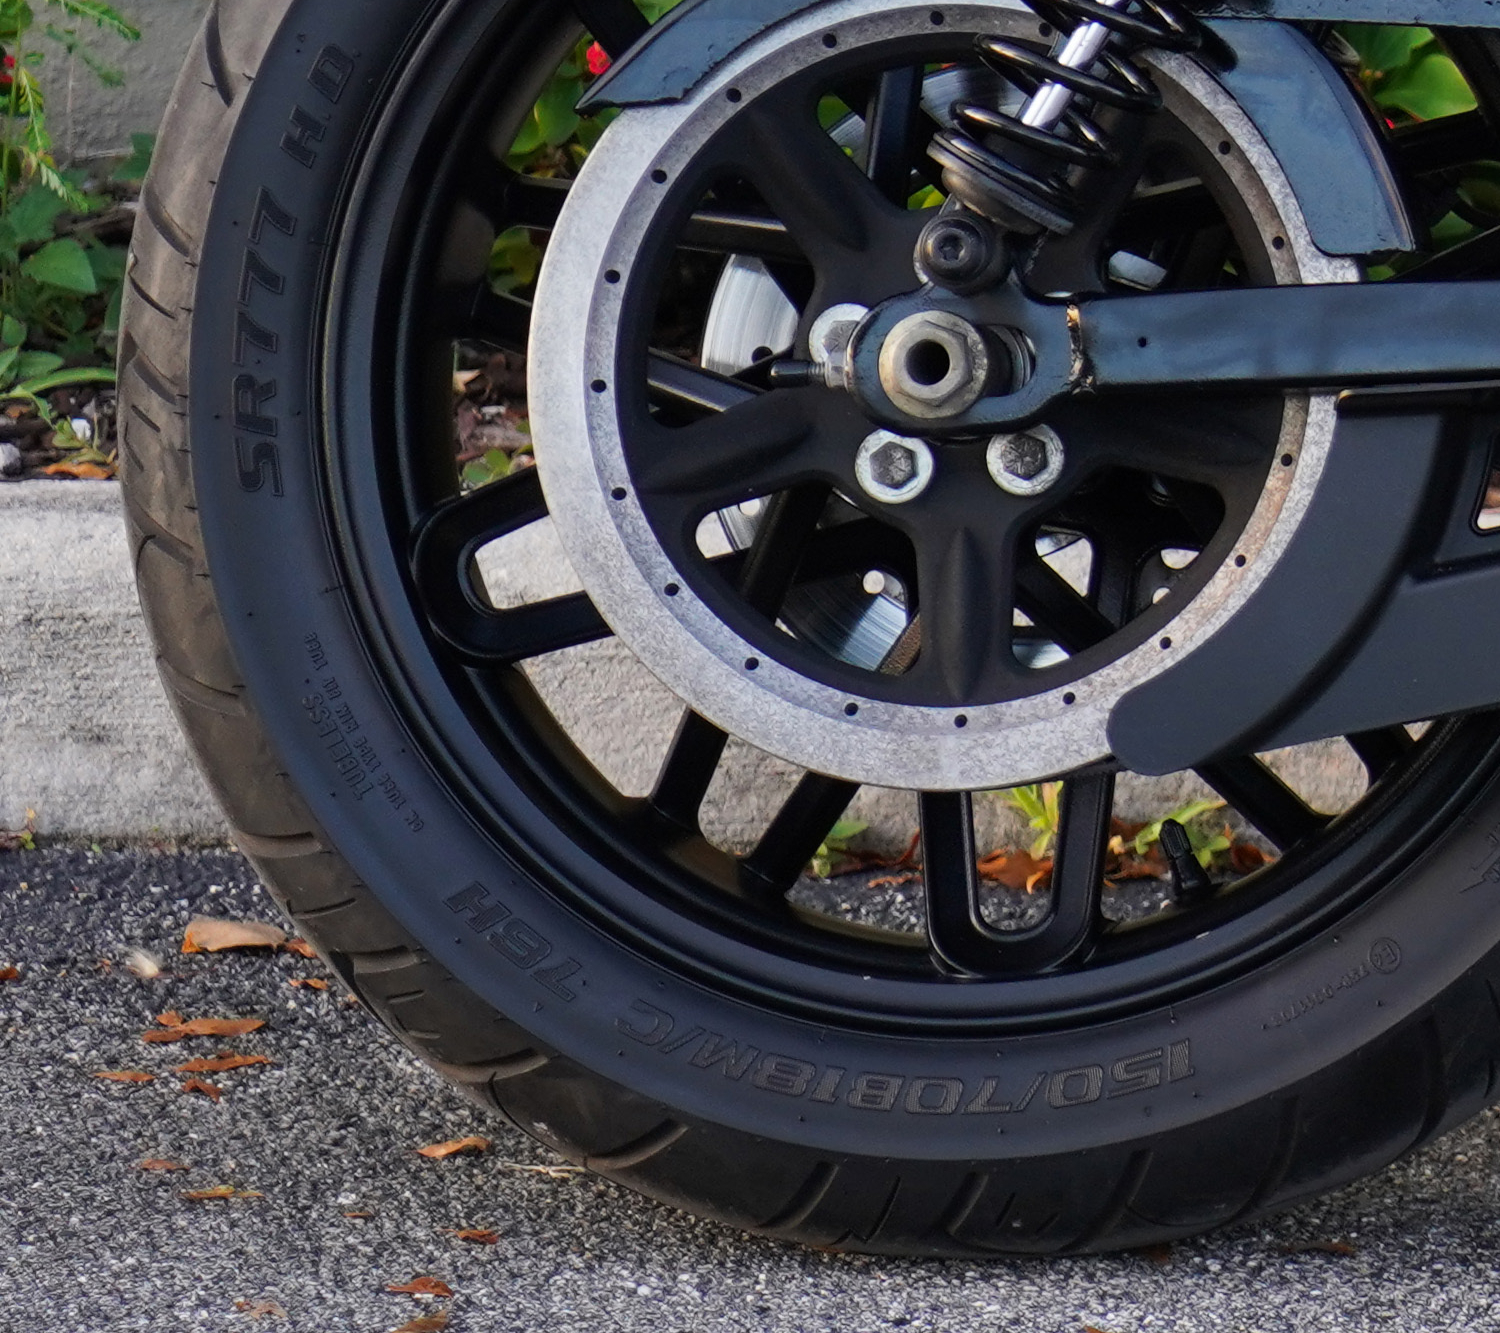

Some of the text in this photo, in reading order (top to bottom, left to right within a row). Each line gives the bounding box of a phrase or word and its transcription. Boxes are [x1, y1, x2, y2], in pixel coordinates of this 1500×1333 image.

[231, 186, 301, 501] SR777
[299, 692, 374, 799] TUBELESS
[446, 881, 585, 995] 76H
